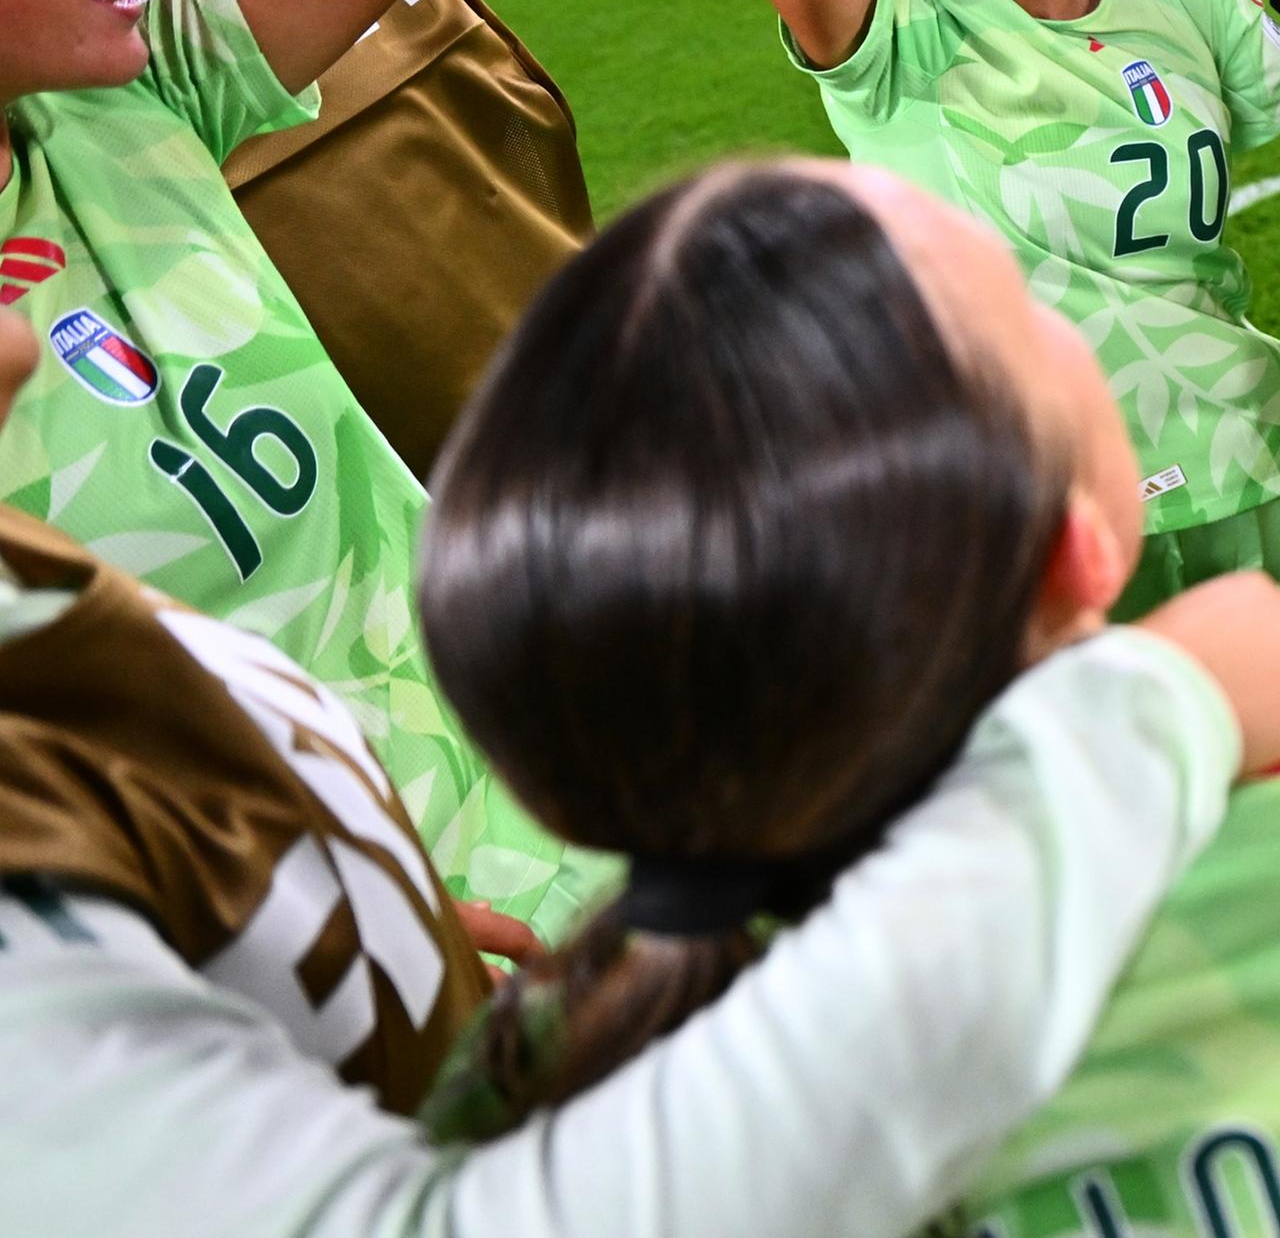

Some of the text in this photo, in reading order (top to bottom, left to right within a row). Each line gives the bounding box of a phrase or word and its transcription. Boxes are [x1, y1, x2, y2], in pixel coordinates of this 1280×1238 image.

[1123, 63, 1153, 85] ITALIA
[1109, 128, 1229, 260] 20
[51, 315, 101, 356] ITALIA
[148, 363, 318, 585] 16
